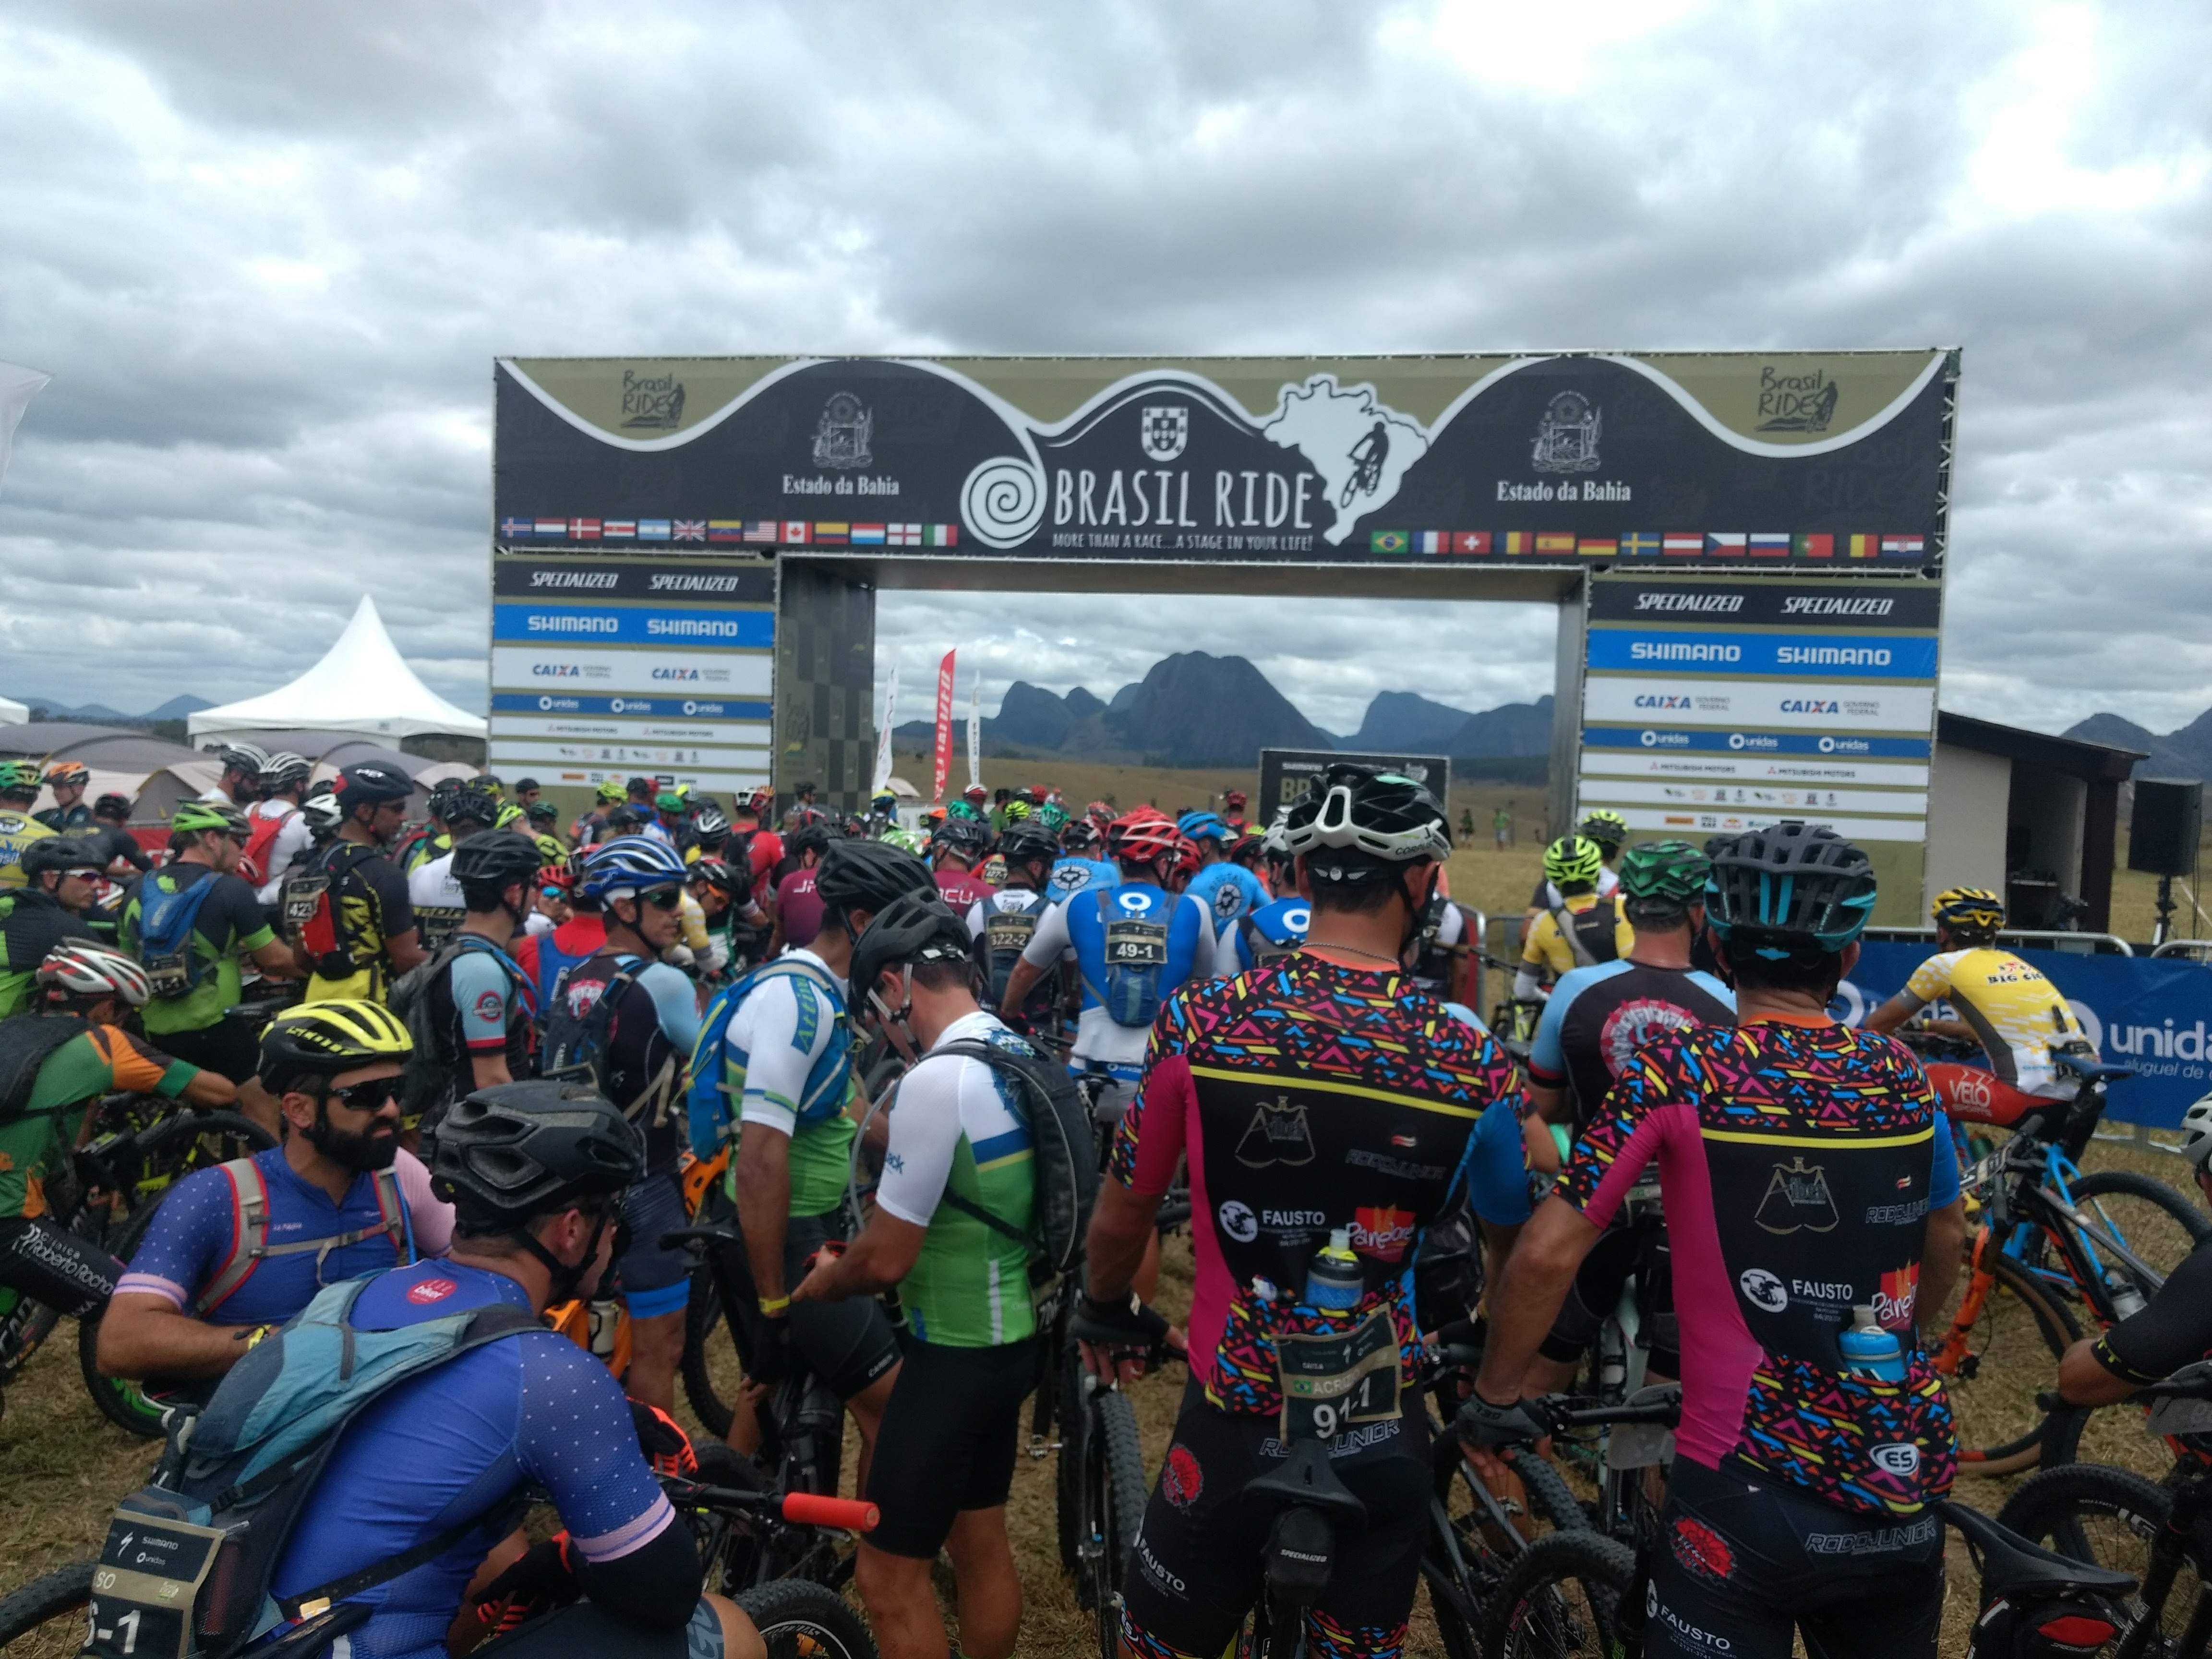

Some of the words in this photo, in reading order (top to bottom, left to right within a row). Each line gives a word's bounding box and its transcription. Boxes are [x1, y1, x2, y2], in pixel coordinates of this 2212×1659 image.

[624, 369, 673, 392] Brasil
[1760, 366, 1821, 392] Brasil
[782, 474, 831, 495] Estado
[834, 474, 854, 495] da
[857, 475, 900, 496] Bahia
[1497, 480, 1553, 501] Estado
[1557, 480, 1578, 501] da
[1583, 480, 1631, 501] Bahia
[1054, 469, 1197, 527] BRASIL
[1215, 471, 1313, 529] RIDE
[1052, 533, 1084, 548] MORE
[1088, 533, 1119, 548] THAN
[1122, 534, 1132, 548] A
[1187, 535, 1223, 549] STAGE
[1227, 535, 1244, 549] IN
[1247, 535, 1278, 550] YOUR
[529, 571, 619, 589] SPECIALIZED
[649, 574, 739, 592] SPECIALIZED
[1635, 593, 1744, 612] SPECIALIZED
[1780, 596, 1894, 615] SPECIALIZED
[528, 615, 618, 633] SHIMANO
[647, 619, 738, 637] SHIMANO
[1631, 642, 1742, 662] SHIMANO
[1777, 647, 1891, 666] SHIMANO
[533, 664, 579, 677] CAIXA
[652, 668, 699, 681] CAIXA
[1635, 695, 1691, 709] CAIXA
[1780, 699, 1839, 714] CAIXA
[1657, 733, 1690, 745] unidas
[1745, 735, 1779, 748] unidas
[1835, 740, 1870, 751] unidas
[1116, 943, 1154, 959] 49-1
[1987, 975, 2018, 984] BIG
[2110, 1017, 2212, 1062] unid
[2182, 1064, 2204, 1080] de
[1949, 1078, 1991, 1107] VELO
[1262, 1209, 1326, 1226] FAUSTO
[30, 1239, 78, 1276] Roberto
[1791, 1278, 1853, 1301] FAUSTO
[1313, 1376, 1371, 1439] 91-1
[1886, 1451, 1912, 1468] ES
[142, 1536, 179, 1551] SHIMANO
[1138, 1537, 1186, 1593] FAUSTO
[1281, 1548, 1328, 1564] SPECIALIZED
[1661, 1605, 1731, 1650] FAUSTO
